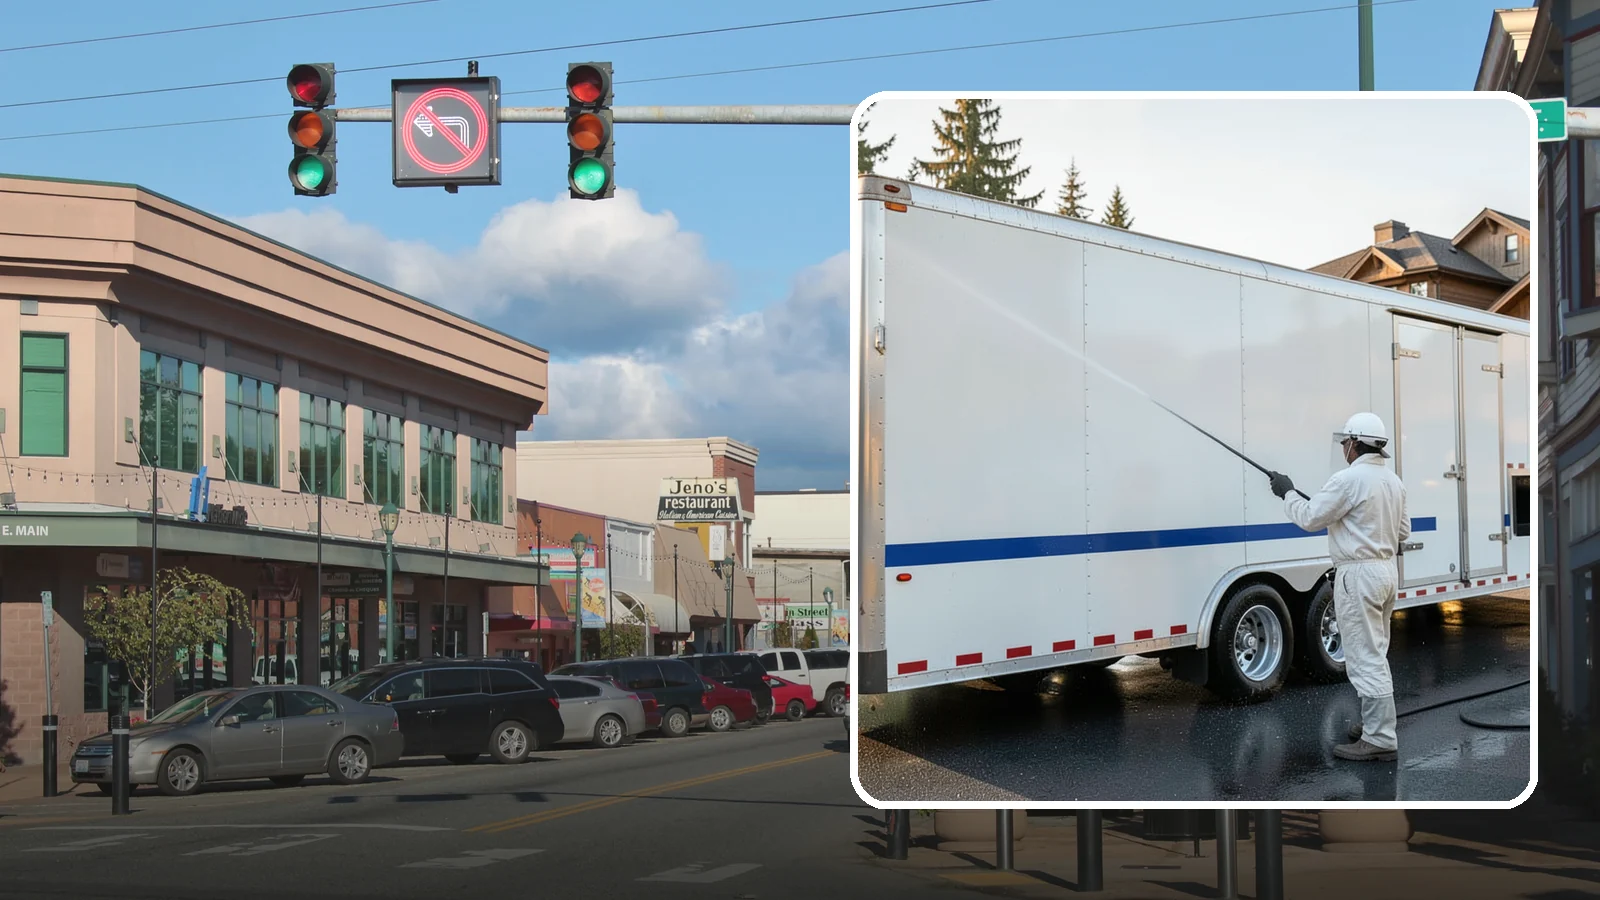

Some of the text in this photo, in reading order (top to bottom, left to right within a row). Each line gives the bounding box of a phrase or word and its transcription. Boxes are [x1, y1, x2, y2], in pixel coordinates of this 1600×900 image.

[670, 480, 728, 494] Jeno's
[665, 496, 731, 509] restaurant
[659, 510, 681, 520] Italian
[686, 509, 715, 519] American
[714, 509, 737, 519] Cuisine
[2, 525, 49, 536] E. MAIN
[797, 607, 828, 617] Street
